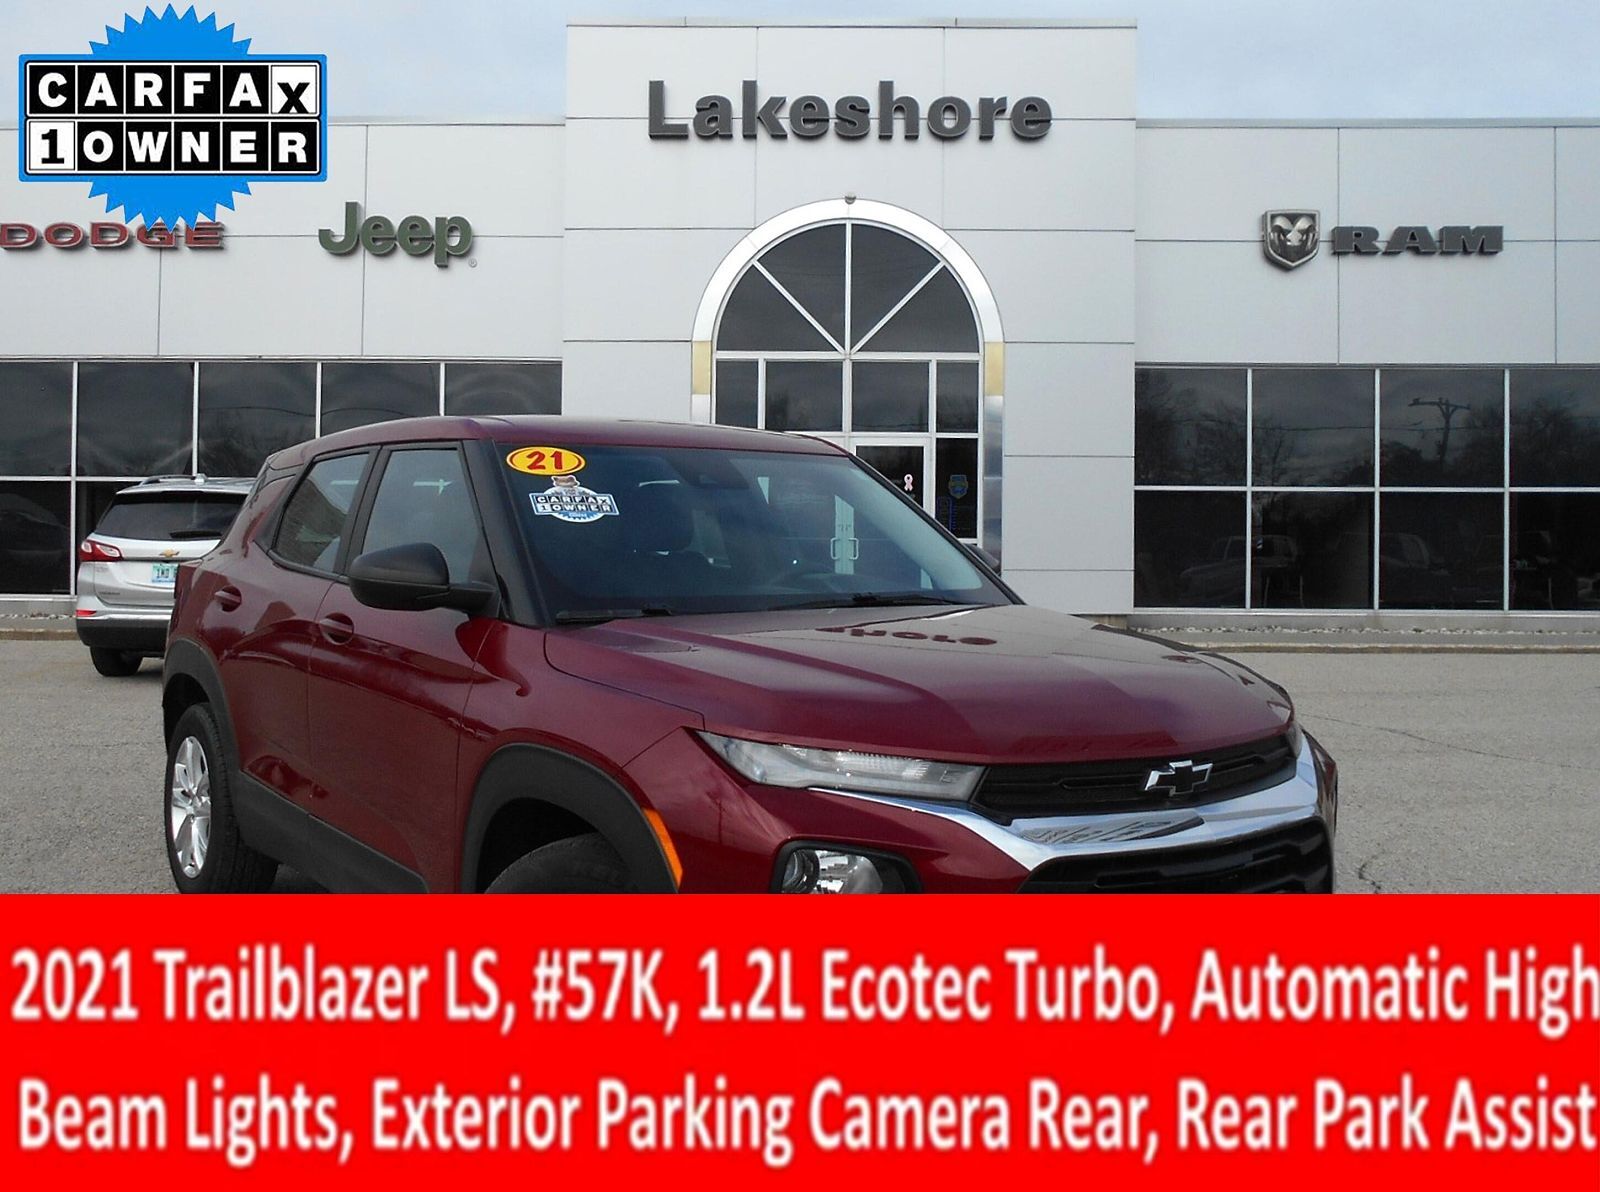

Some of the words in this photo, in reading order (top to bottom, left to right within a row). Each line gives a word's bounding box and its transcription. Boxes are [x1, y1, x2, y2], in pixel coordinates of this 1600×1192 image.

[648, 80, 1053, 141] Lakeshore
[0, 222, 224, 250] DODGE
[318, 201, 473, 268] Jeep
[1331, 225, 1504, 255] RAM
[526, 450, 563, 471] 21
[537, 496, 609, 505] CARFAX
